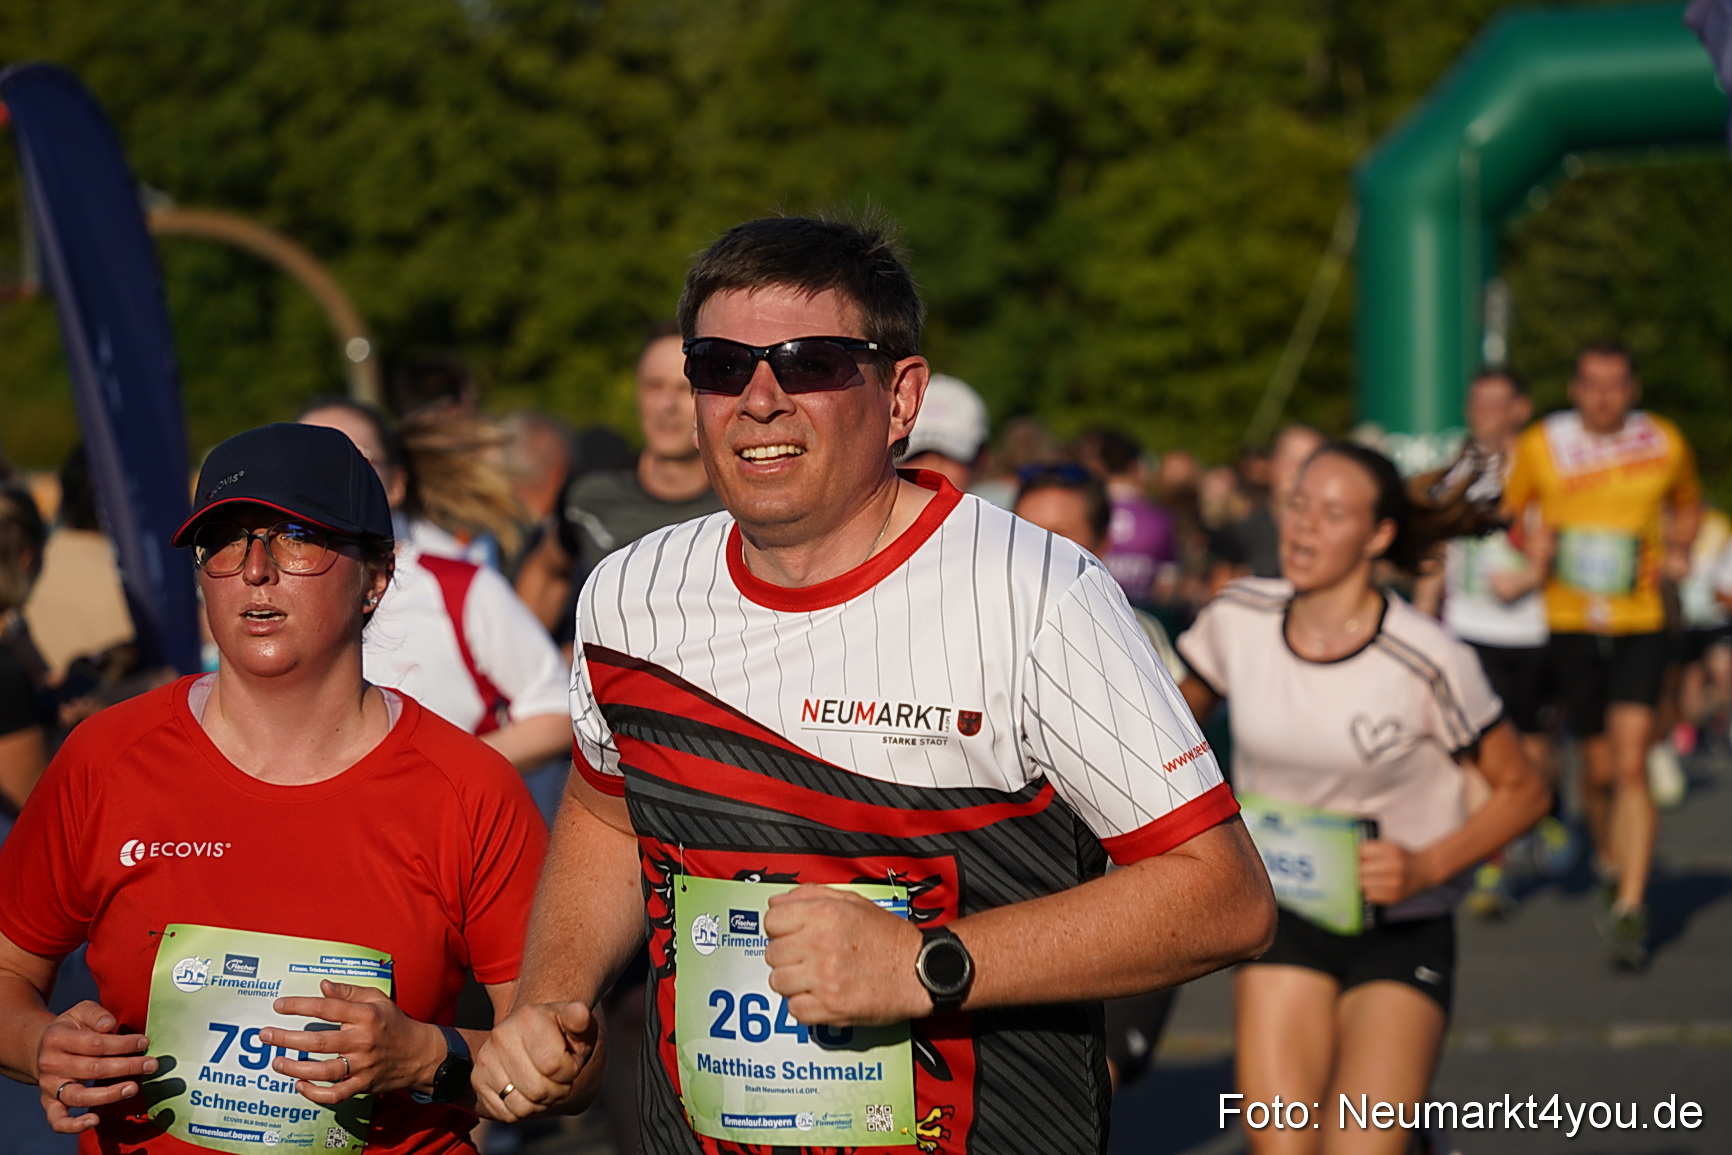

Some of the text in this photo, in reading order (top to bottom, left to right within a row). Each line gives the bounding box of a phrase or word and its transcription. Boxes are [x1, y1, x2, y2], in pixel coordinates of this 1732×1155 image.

[801, 698, 952, 732] NEUMARKT
[882, 736, 948, 746] STARKE STADT
[149, 842, 224, 857] ECOVIS
[210, 975, 282, 992] Firmenlauf
[237, 988, 279, 998] neumarkt
[697, 1053, 883, 1081] Matthias Schmalzl
[745, 1085, 761, 1093] Stadt
[762, 1086, 794, 1094] Neumarkt
[189, 1090, 321, 1123] Schneeberger
[223, 1116, 243, 1124] ECOVIS
[724, 1115, 793, 1128] firmenlauf.bayern
[191, 1126, 260, 1142] firmenlauf.bayern
